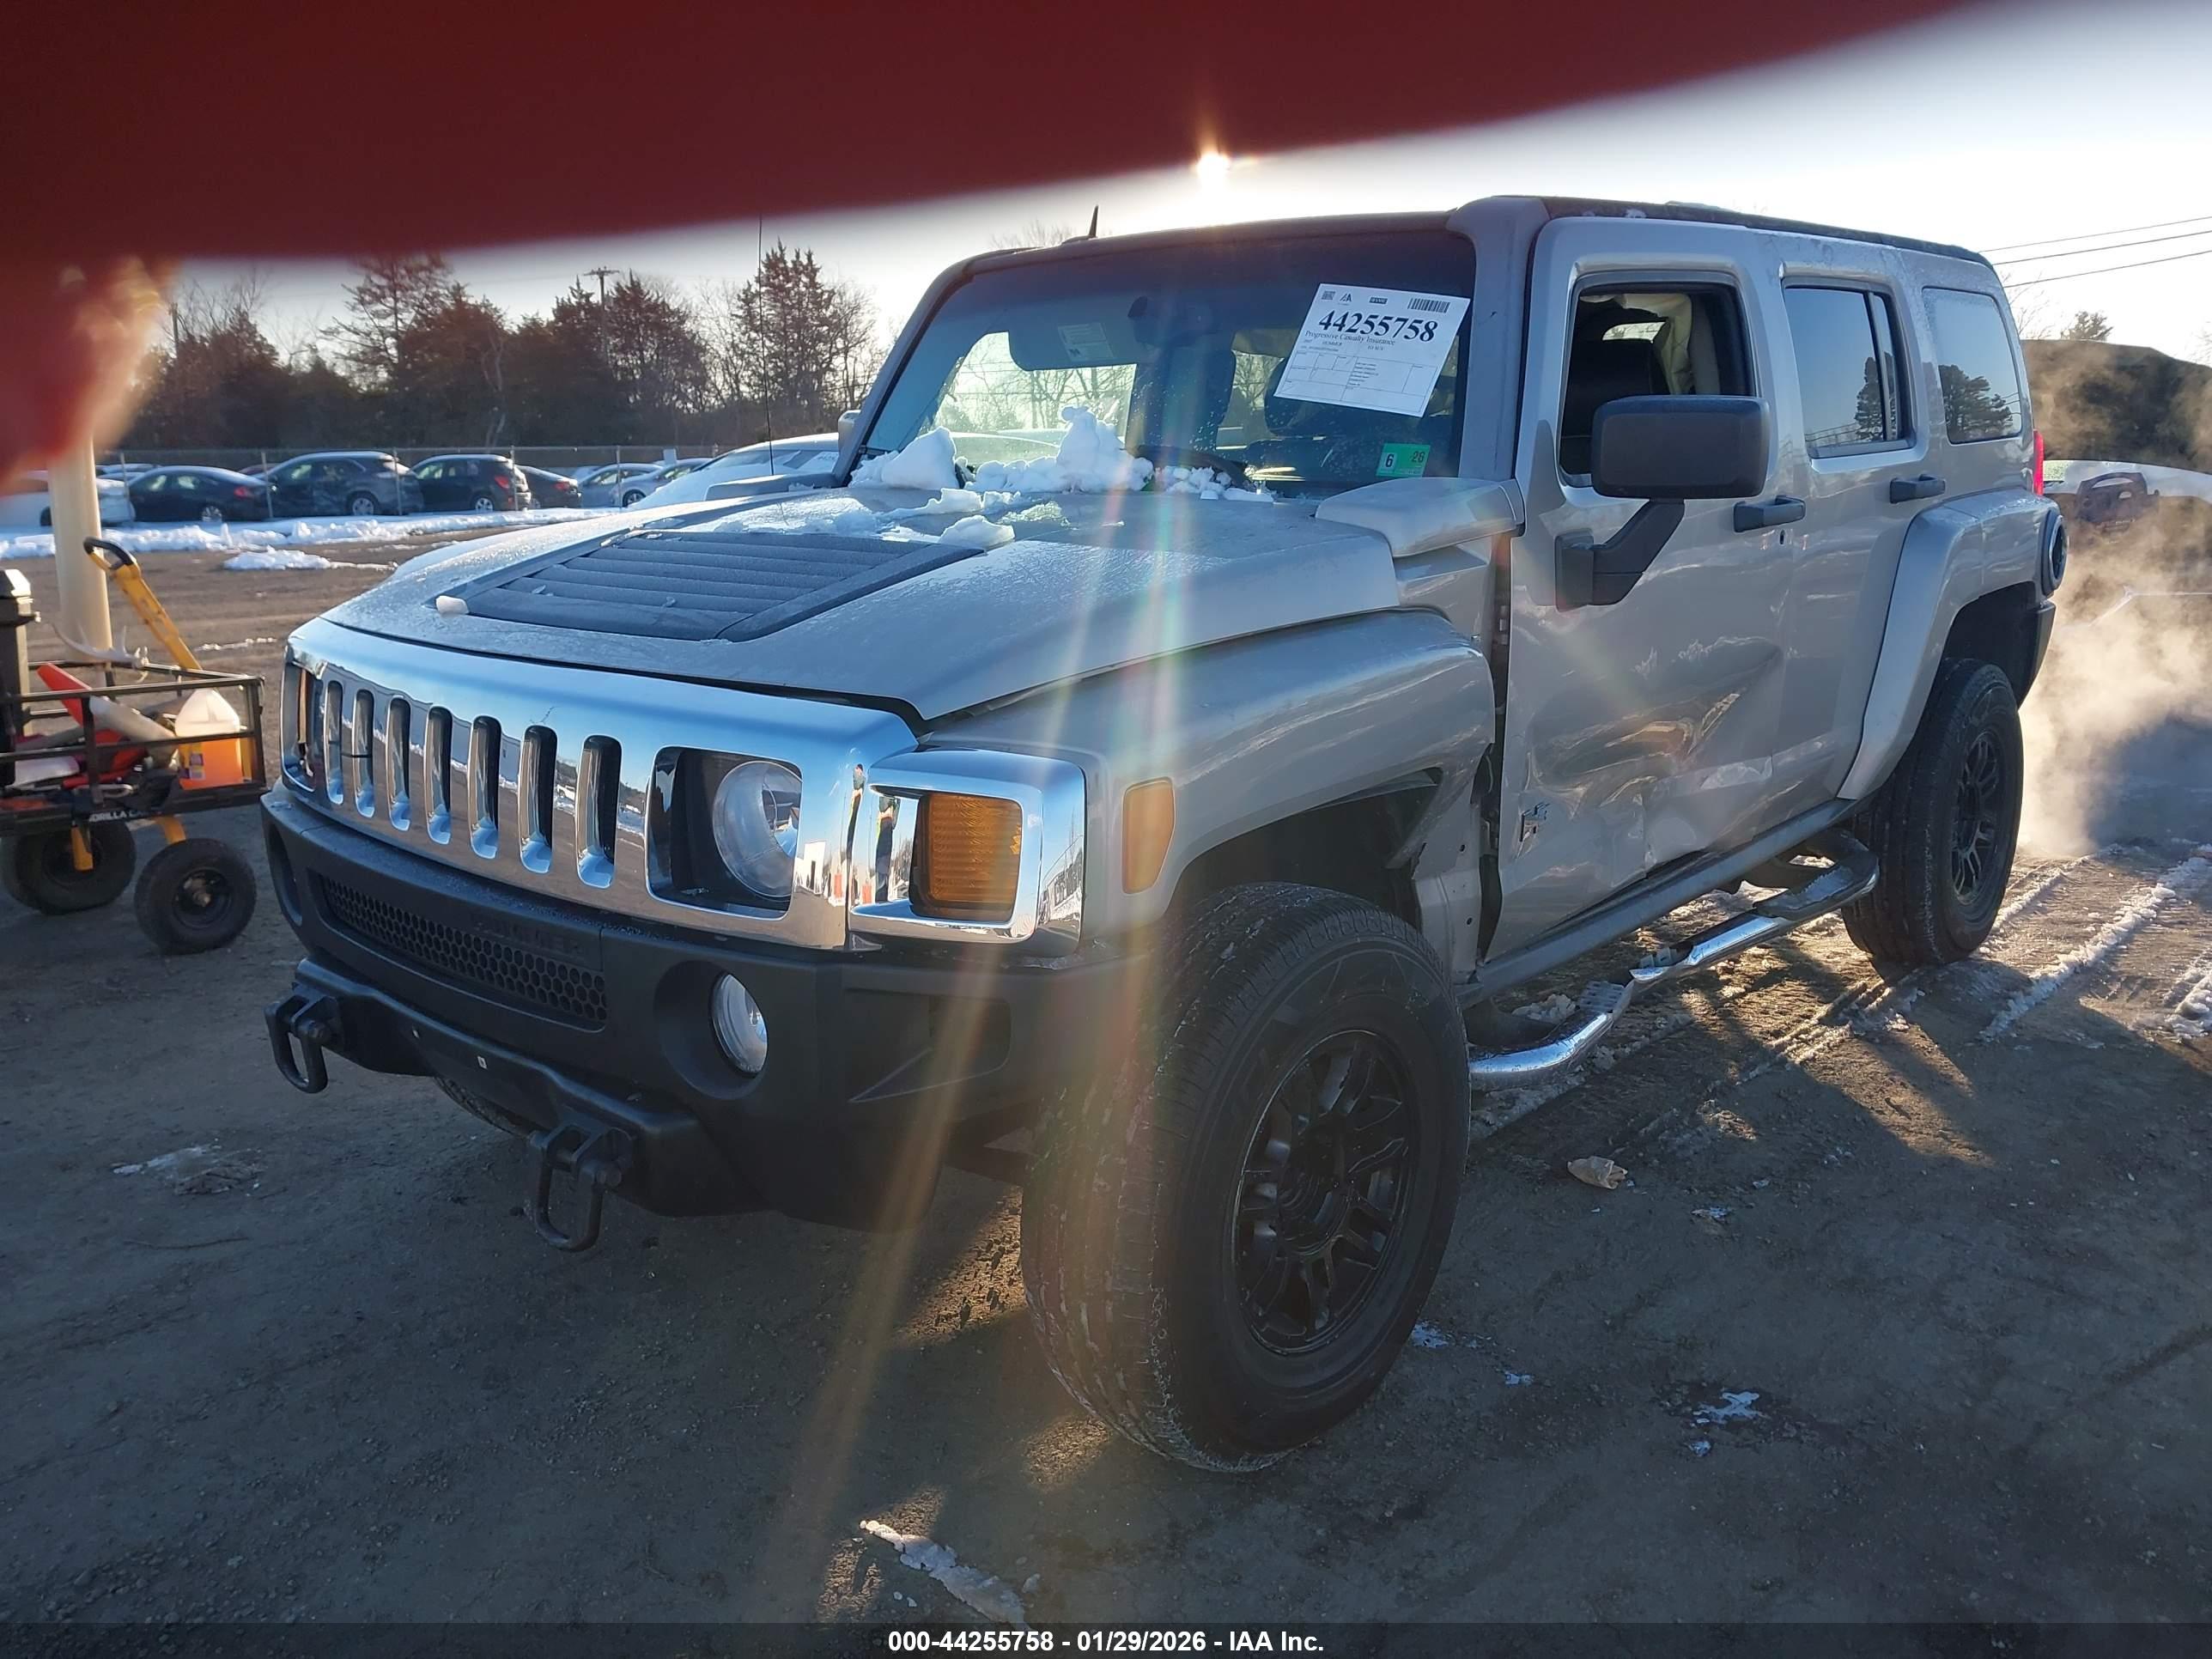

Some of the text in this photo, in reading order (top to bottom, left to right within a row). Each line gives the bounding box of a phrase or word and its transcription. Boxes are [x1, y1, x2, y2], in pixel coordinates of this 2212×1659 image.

[1319, 310, 1438, 343] 44255758
[1305, 330, 1395, 345] Progressive Casualty Insurance
[1385, 453, 1395, 468] 6
